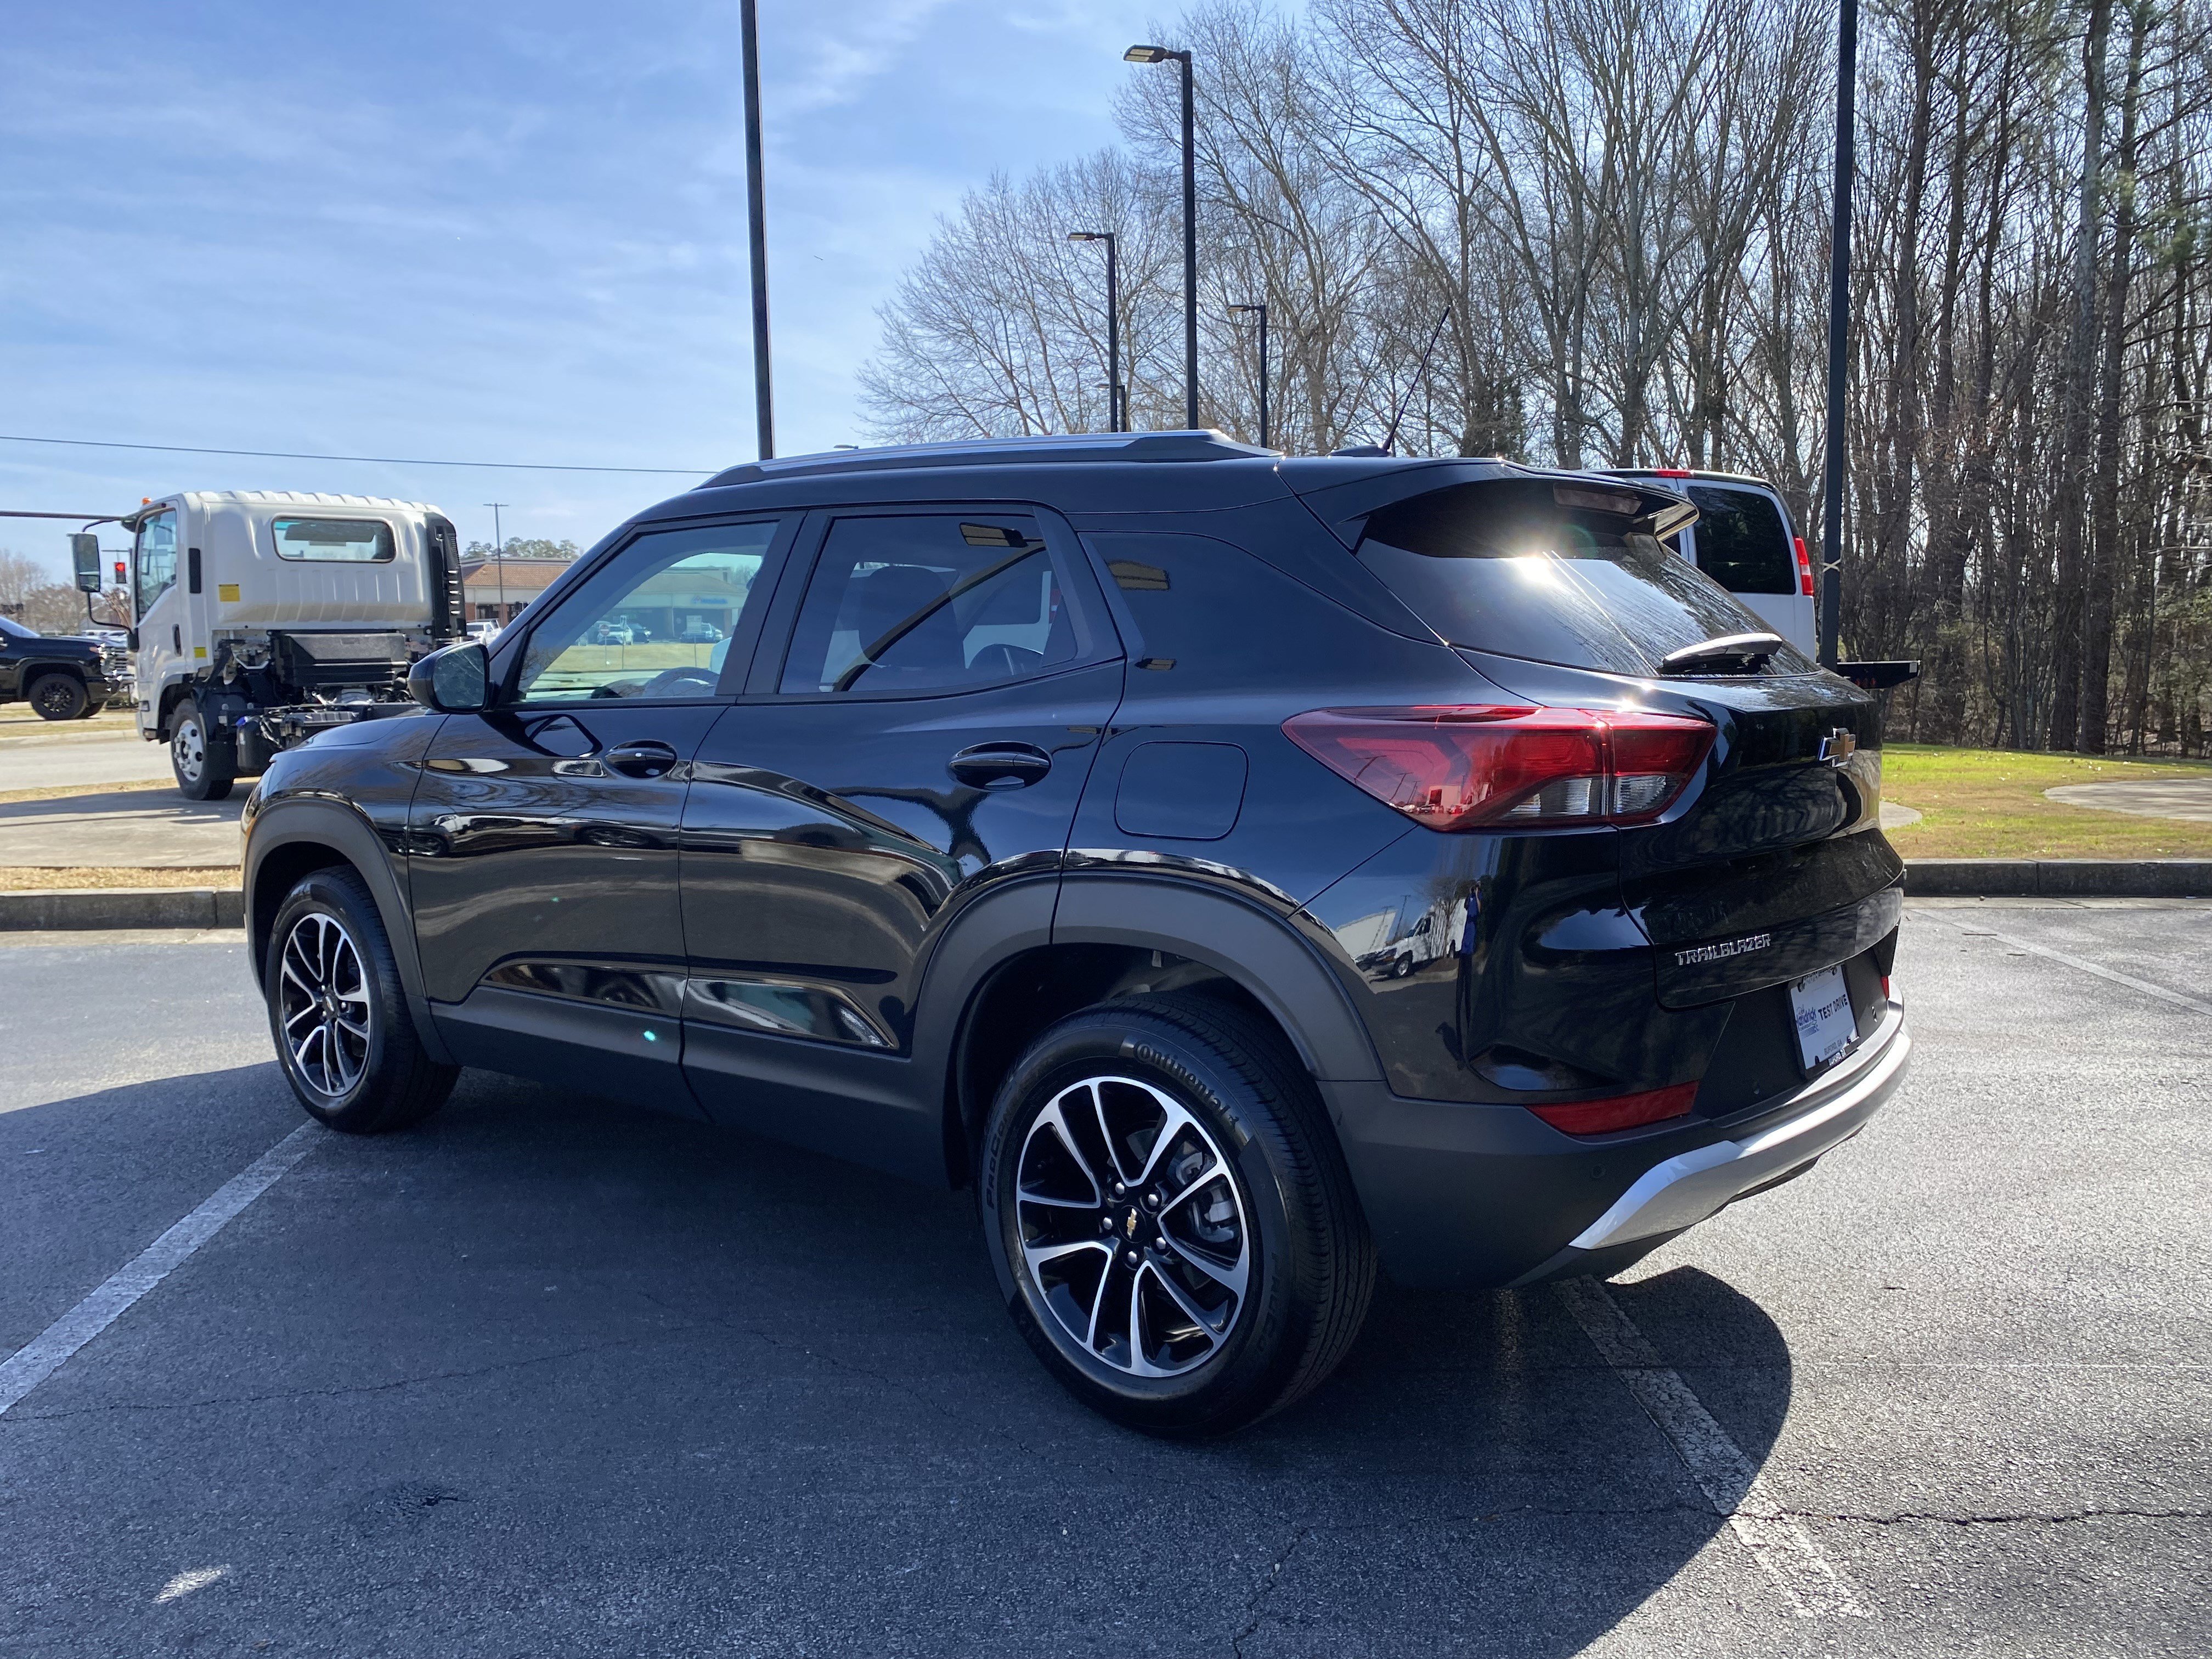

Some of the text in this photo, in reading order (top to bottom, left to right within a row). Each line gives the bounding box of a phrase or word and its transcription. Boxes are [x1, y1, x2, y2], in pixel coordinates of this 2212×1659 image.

[1675, 933, 1771, 966] TRAILBLAZER
[1818, 994, 1848, 1020] TEST DRIVE
[1133, 1042, 1231, 1116] Continental
